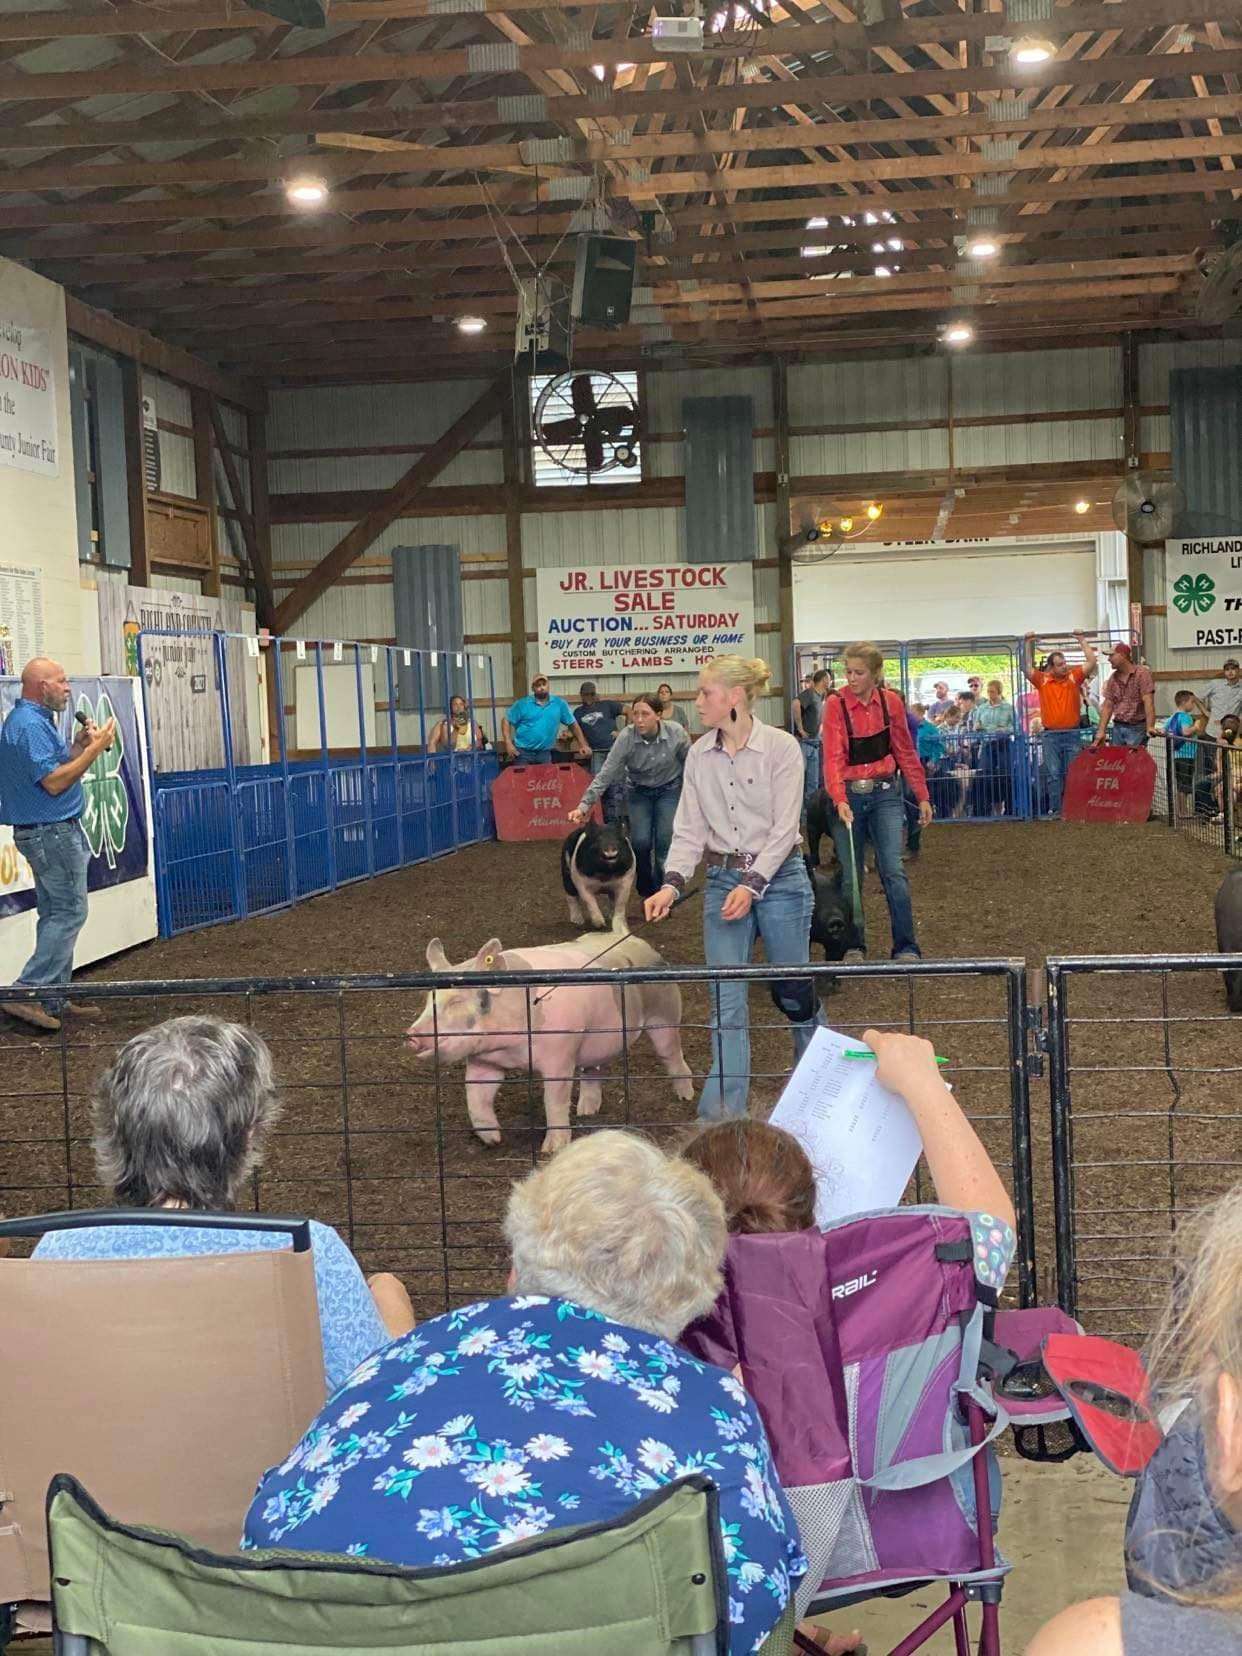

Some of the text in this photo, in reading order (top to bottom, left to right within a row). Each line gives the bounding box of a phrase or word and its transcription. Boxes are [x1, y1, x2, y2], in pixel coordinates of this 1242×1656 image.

[18, 432, 40, 458] Junior
[42, 439, 56, 463] Fair
[1182, 540, 1242, 555] RICHLAND
[1231, 556, 1242, 569] LI
[560, 567, 727, 591] JR. LIVESTOCK
[614, 592, 675, 612] SALE
[140, 609, 211, 639] RICHLAND COUNTY
[653, 613, 739, 631] SATURDAY
[551, 633, 745, 649] BUY FOR YOUR BUSINESS OR HOME
[562, 645, 714, 658] CUSTOM BUTCHERING ARRANGED
[553, 658, 604, 669] STEERS
[622, 656, 673, 668] LAMBS
[527, 779, 563, 792] Shelby
[1096, 778, 1120, 790] FFA
[533, 797, 561, 809] FFA
